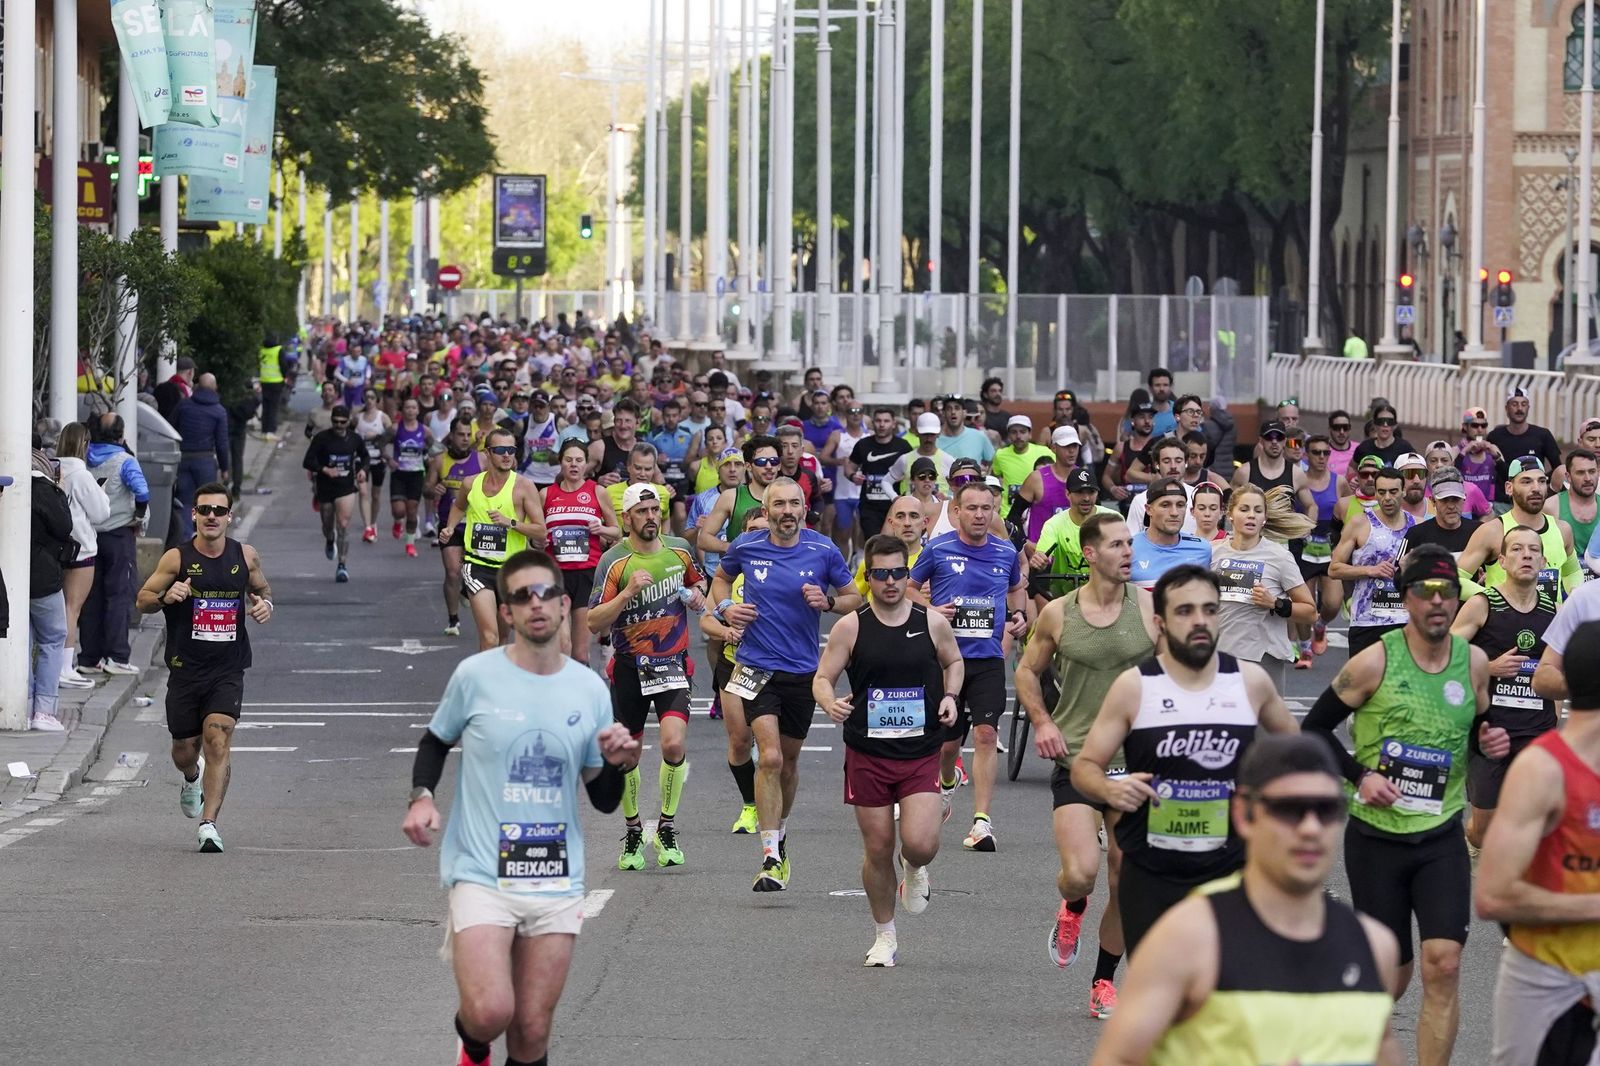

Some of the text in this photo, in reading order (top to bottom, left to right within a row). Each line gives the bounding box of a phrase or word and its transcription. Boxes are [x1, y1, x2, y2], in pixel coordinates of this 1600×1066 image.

[567, 506, 596, 514] STRIDERS
[478, 541, 497, 550] LEON
[1232, 561, 1258, 569] ZURICH
[956, 618, 989, 627] LA BIGE
[887, 690, 918, 698] ZURICH
[879, 716, 914, 726] SALAS
[1405, 748, 1446, 763] ZURICH
[503, 787, 563, 804] SEVILLA
[1176, 788, 1220, 798] ZURICH
[1165, 821, 1210, 835] JAIME
[506, 861, 564, 876] REIXACH
